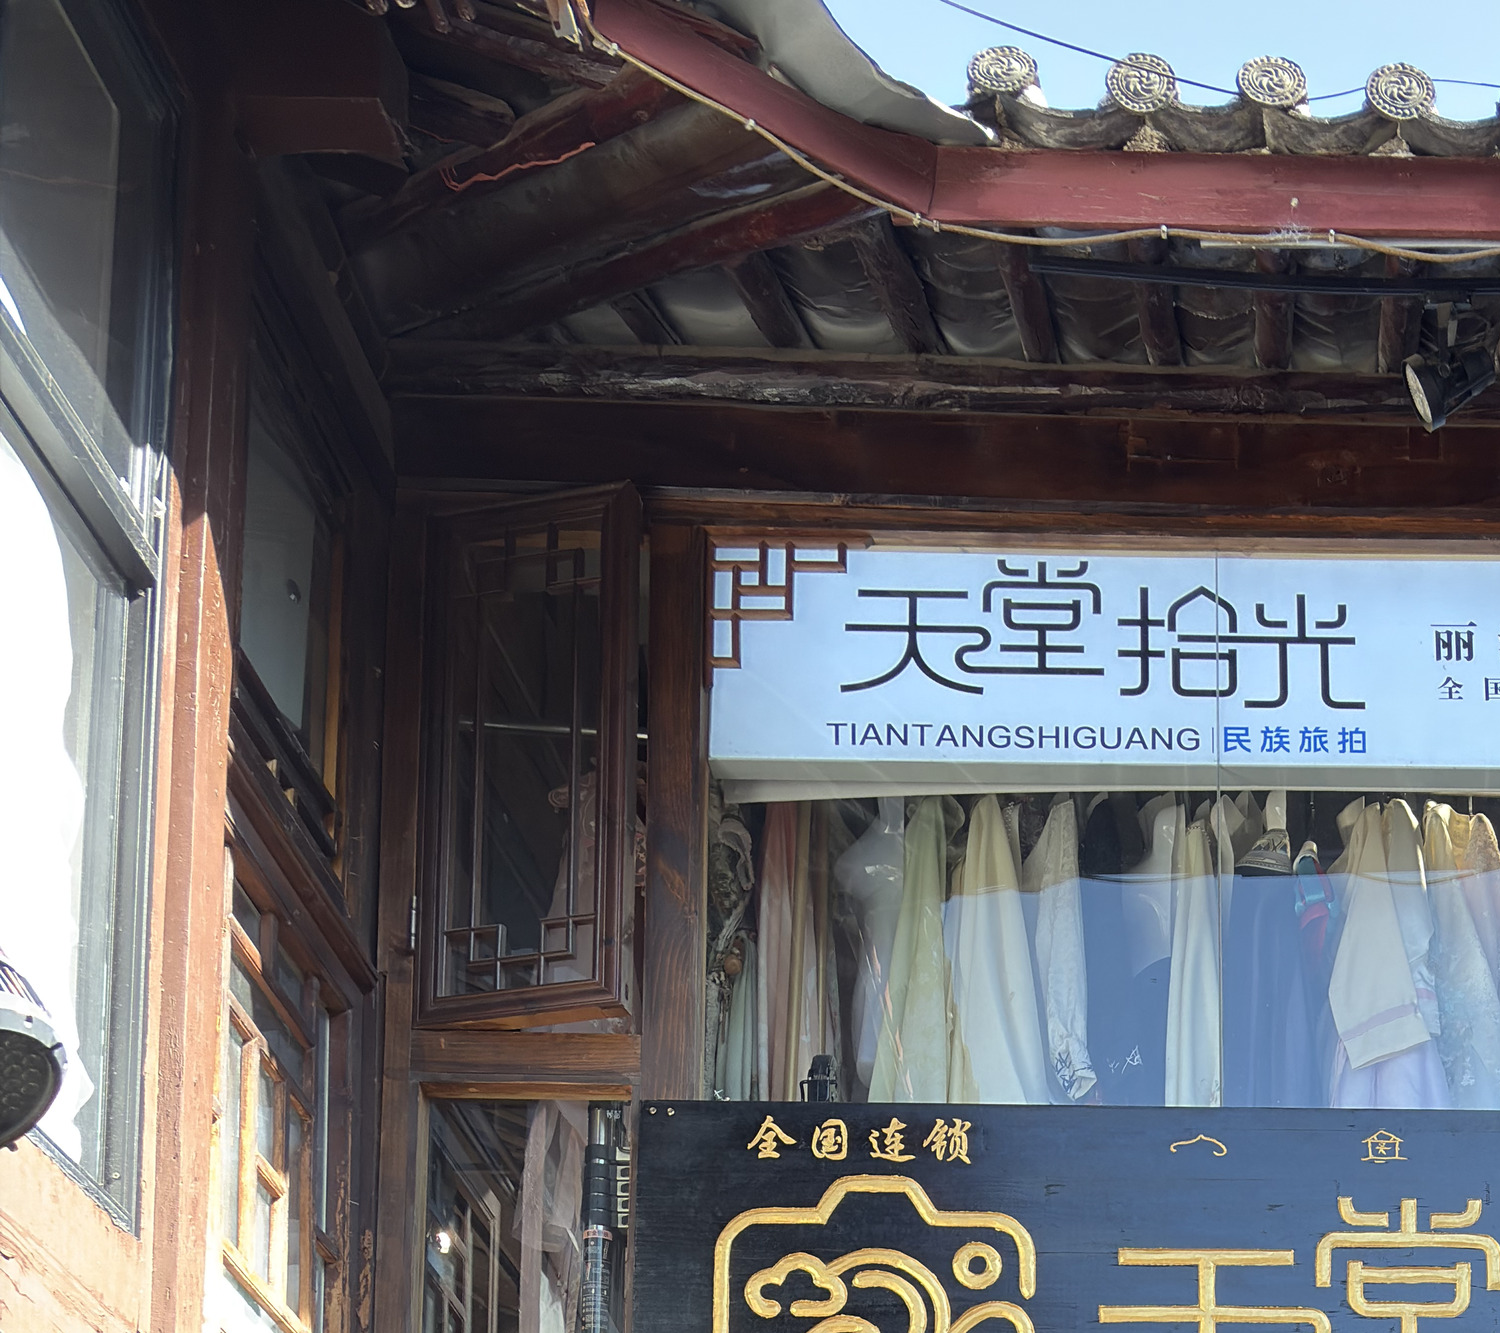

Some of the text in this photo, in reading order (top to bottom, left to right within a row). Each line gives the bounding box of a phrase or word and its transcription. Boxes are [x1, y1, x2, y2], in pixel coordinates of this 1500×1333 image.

[840, 558, 1367, 711] 天堂拾光
[826, 722, 1369, 756] TIANTANGSHIGUANG 民族旅拍
[747, 1115, 972, 1164] 全国连锁
